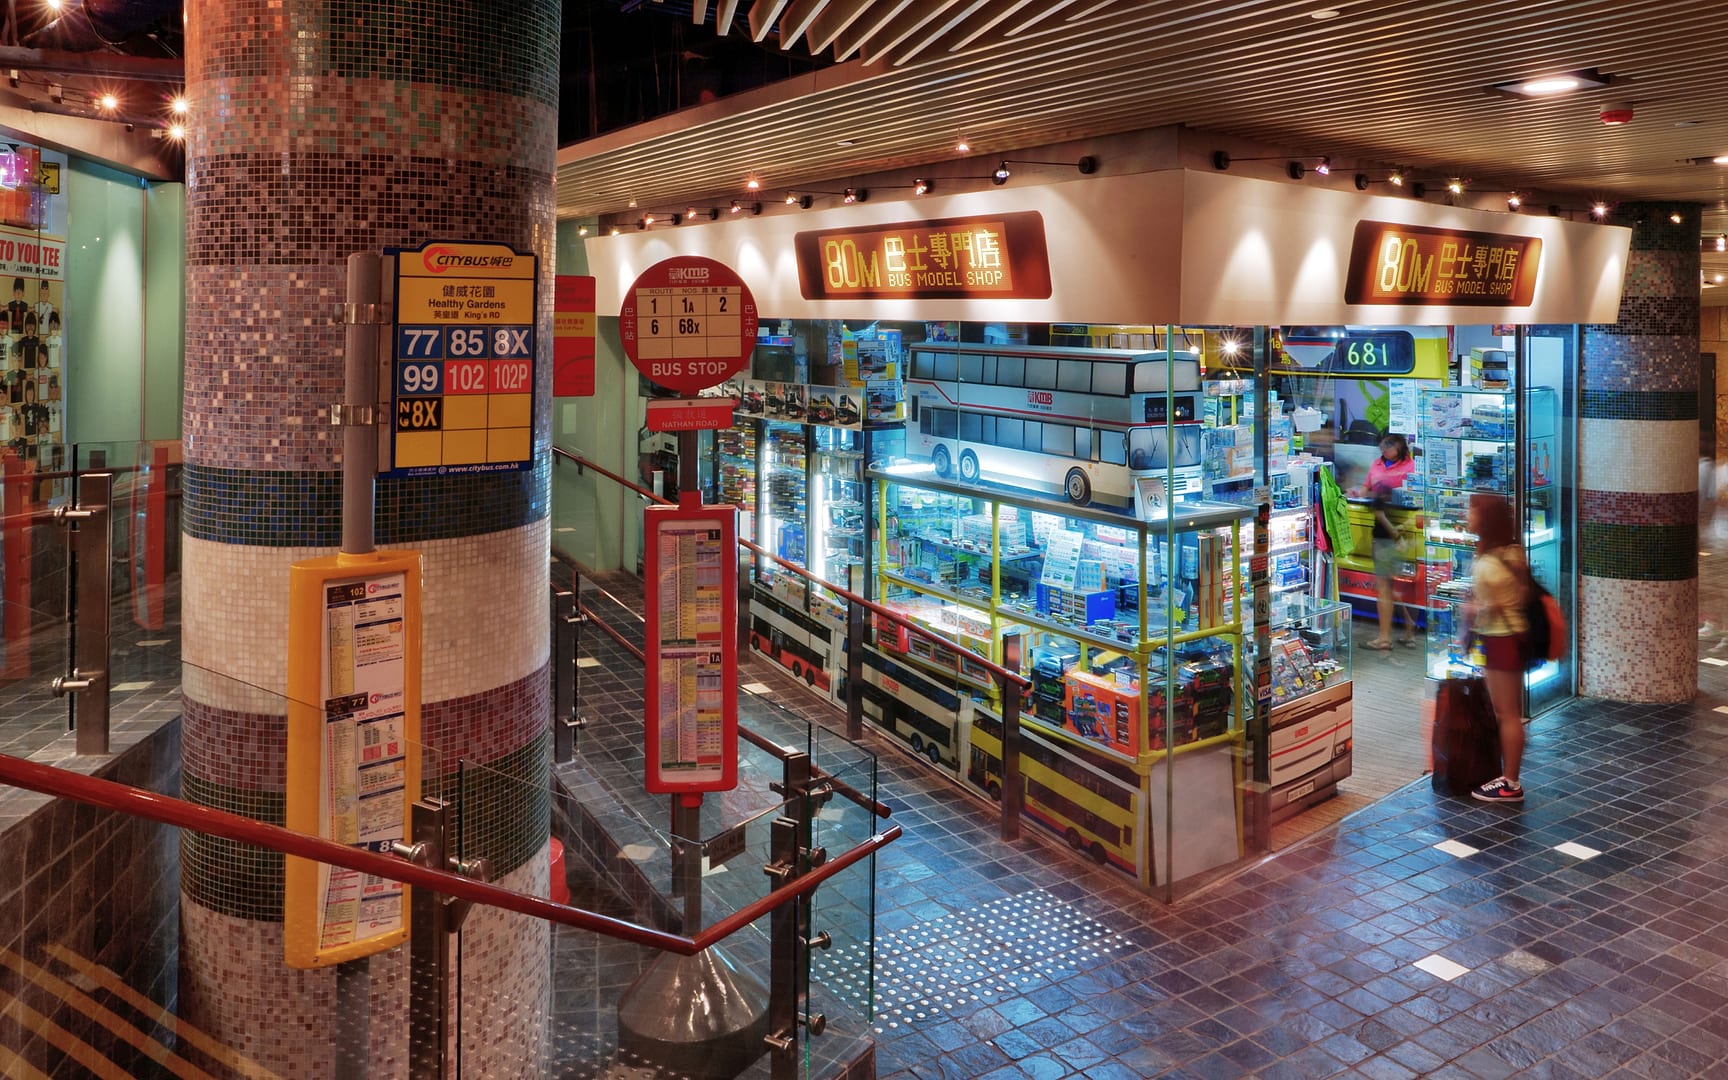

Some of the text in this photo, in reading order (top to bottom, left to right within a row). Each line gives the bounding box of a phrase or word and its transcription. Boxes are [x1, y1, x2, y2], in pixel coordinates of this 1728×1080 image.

[17, 242, 40, 265] YOU
[43, 246, 60, 267] TEE
[884, 230, 1001, 272] 巴士專門店
[437, 255, 513, 267] CITYBUS 城巴
[824, 239, 881, 289] 80M
[1380, 237, 1435, 293] 80M
[1438, 241, 1519, 281] 巴士專門店
[680, 267, 710, 280] KMB
[888, 270, 1003, 287] BUS MODEL SHOP
[442, 285, 495, 298] 健威花園
[1434, 279, 1512, 296] BUS MODEL SHOP
[428, 298, 506, 310] Healthy Gardens
[651, 296, 727, 314] 1 1A 2
[489, 311, 500, 319] RD
[744, 304, 755, 338] 巴士站
[624, 307, 635, 341] 巴士站
[651, 319, 659, 335] 6
[404, 328, 529, 356] 77 85 8X
[1348, 342, 1388, 366] 681
[403, 363, 528, 391] 99 102 102P
[652, 361, 728, 377] BUS STOP
[661, 419, 719, 429] NATHAN ROAD
[448, 462, 519, 473] www.citybus.com.hk
[350, 587, 365, 597] 102
[351, 697, 365, 707] 77
